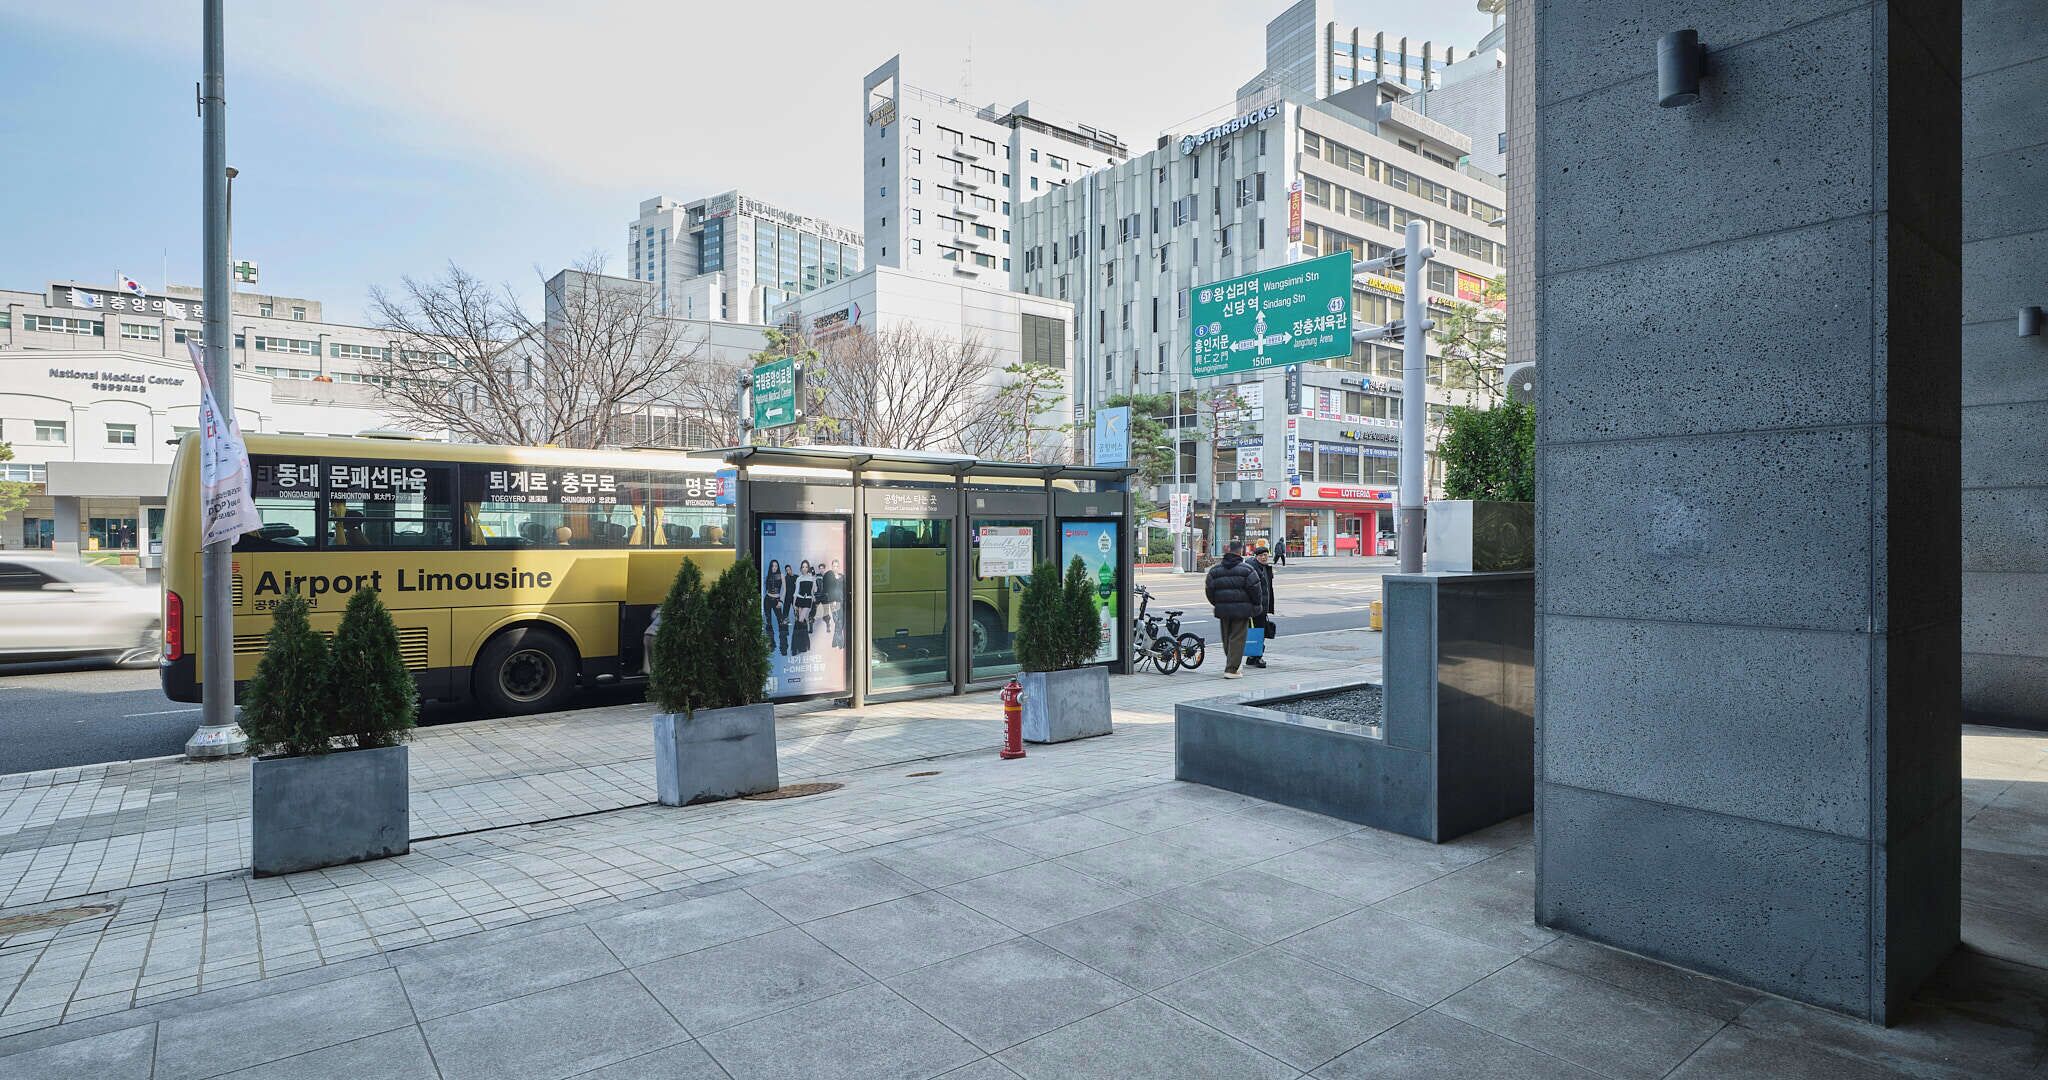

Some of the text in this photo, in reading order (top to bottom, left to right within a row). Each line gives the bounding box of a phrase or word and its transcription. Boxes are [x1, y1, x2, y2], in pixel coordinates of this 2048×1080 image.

[1195, 105, 1278, 146] STARBUCKS
[1213, 278, 1260, 303] 왕십리역
[1263, 271, 1320, 292] Wangsimni Stn
[1222, 296, 1260, 318] 신당역
[1263, 294, 1306, 311] Sindang Stn
[1292, 313, 1348, 336] 장충체육관
[1194, 334, 1229, 353] 흥인지문
[1252, 356, 1272, 368] 150m
[48, 368, 185, 387] National Medical Center
[1287, 434, 1296, 462] 피부과
[279, 490, 371, 501] DONGDAEMUN FASHIONTOWN
[685, 478, 717, 498] 명동
[1341, 489, 1371, 498] LOTTERIA
[490, 494, 526, 503] TOEGYERO
[560, 495, 596, 504] CHUNGMURO
[884, 494, 938, 505] 공항버스 타는 곳
[254, 567, 553, 599] Airport Limousine
[254, 598, 319, 611] 공항진
